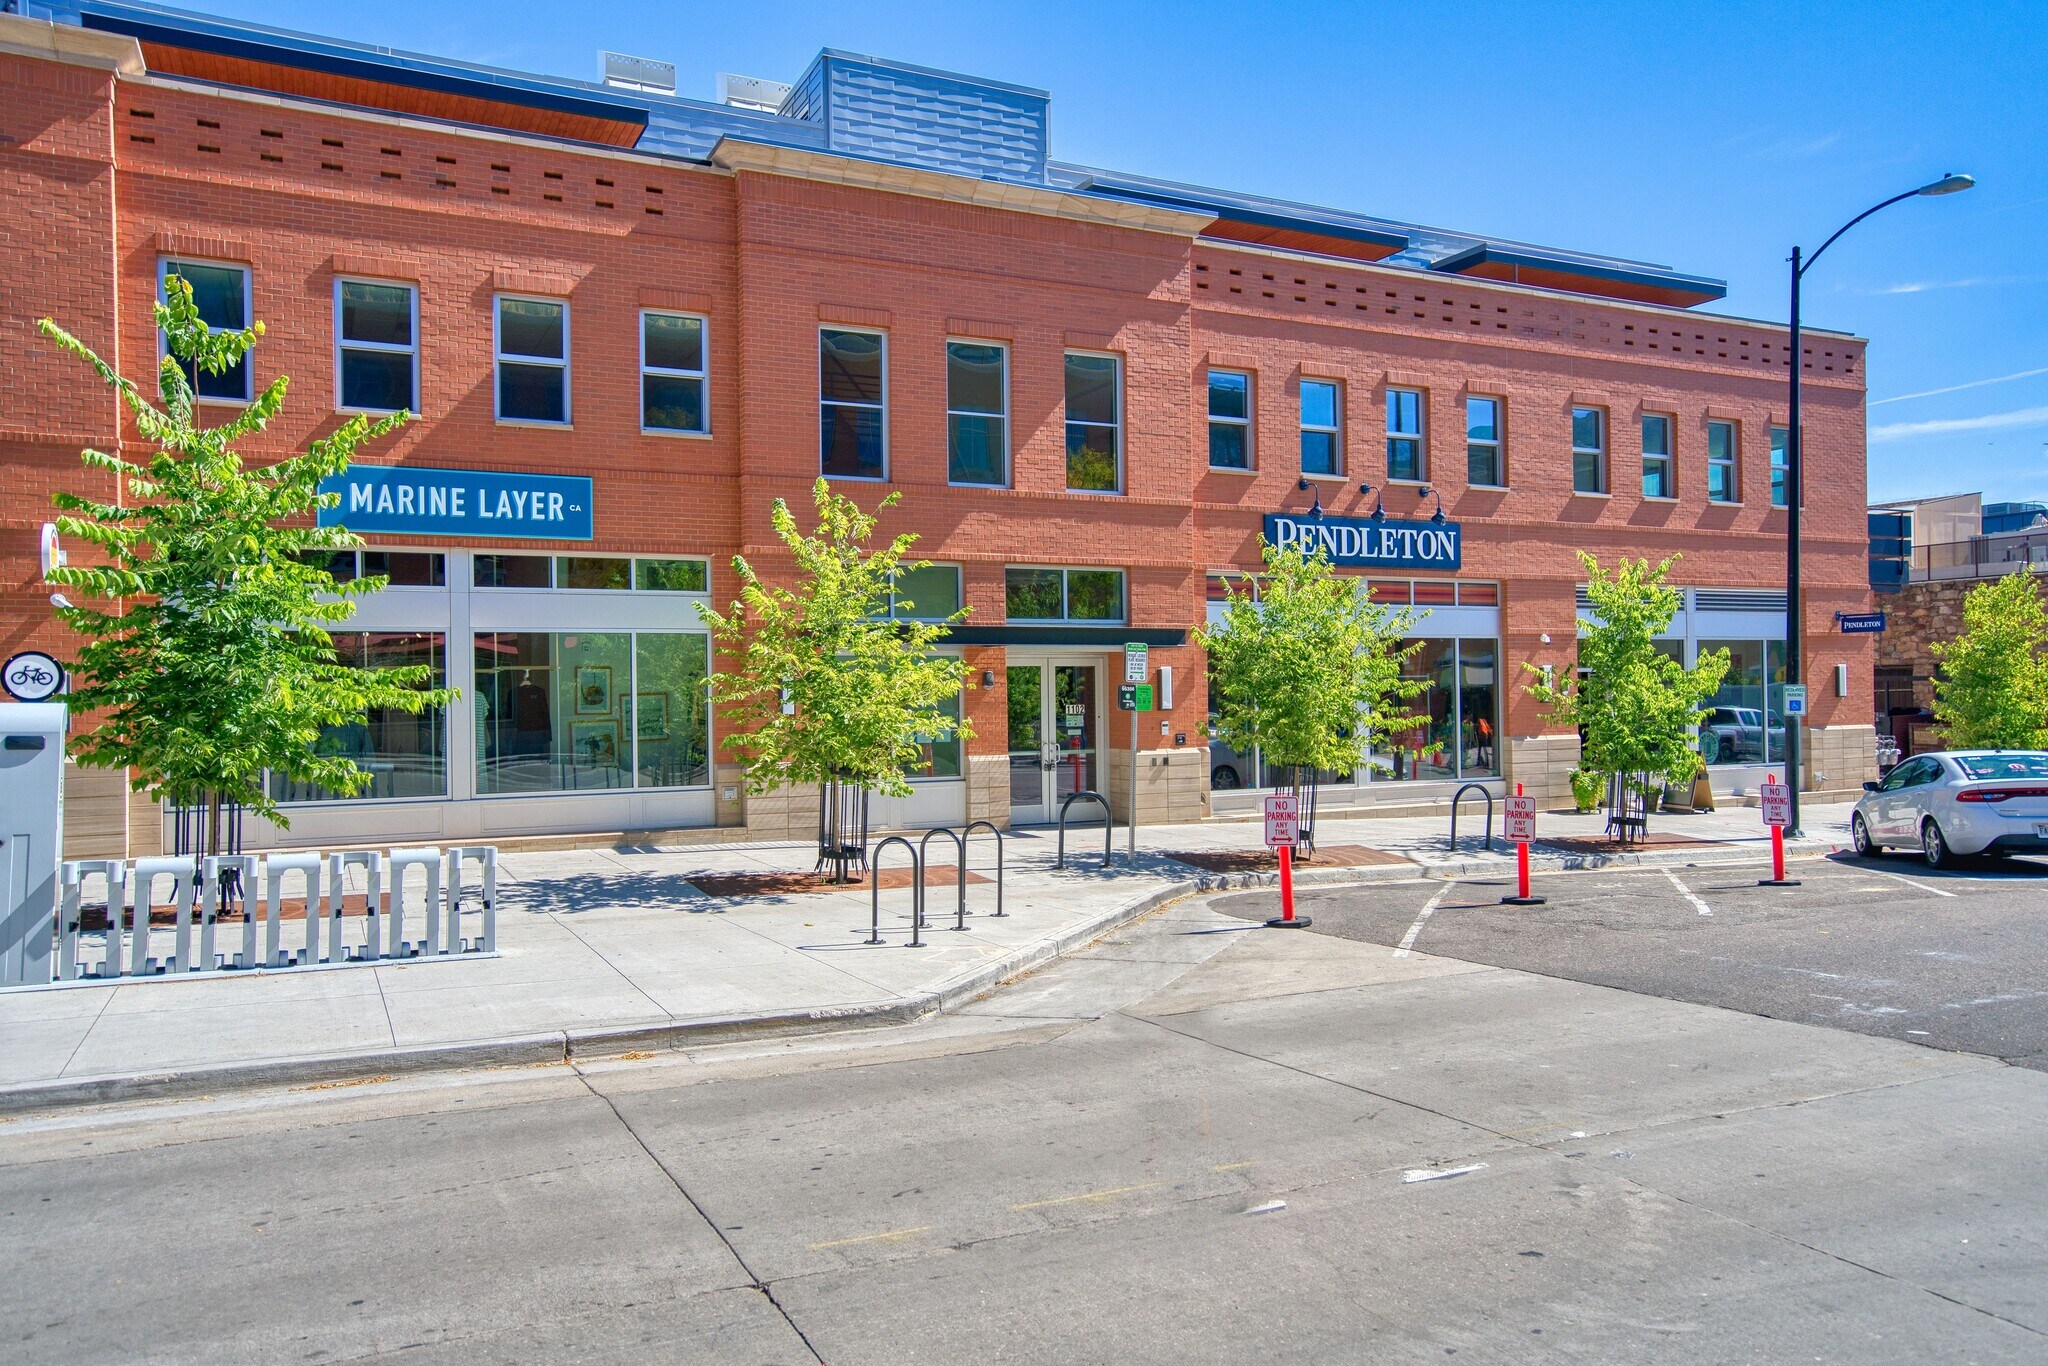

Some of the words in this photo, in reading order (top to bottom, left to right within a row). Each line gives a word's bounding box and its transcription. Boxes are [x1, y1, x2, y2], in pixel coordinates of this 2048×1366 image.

[350, 482, 466, 517] MARINE
[478, 488, 564, 521] LAYER
[569, 504, 582, 512] CA
[1274, 518, 1457, 561] PENDLETON
[1844, 621, 1881, 629] PENDLETON
[1066, 704, 1085, 714] 1102
[1769, 788, 1780, 796] NO
[1275, 801, 1288, 810] NO
[1514, 800, 1526, 810] NO
[1763, 796, 1788, 806] PARKING
[1268, 812, 1296, 821] PARKING
[1507, 810, 1534, 820] PARKING
